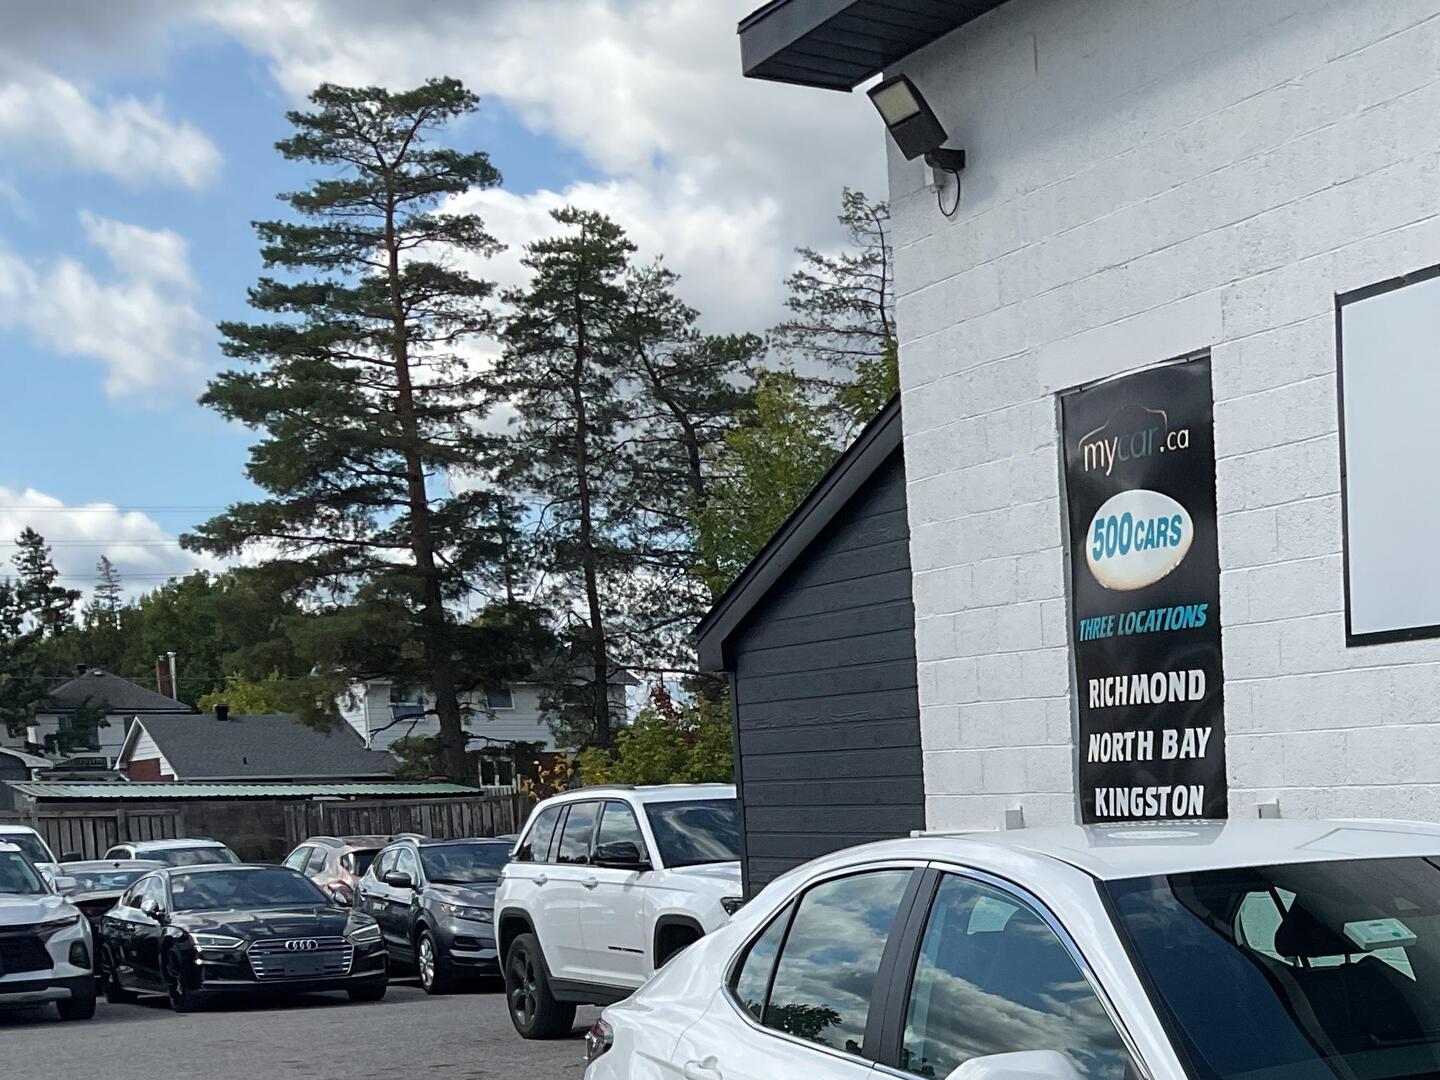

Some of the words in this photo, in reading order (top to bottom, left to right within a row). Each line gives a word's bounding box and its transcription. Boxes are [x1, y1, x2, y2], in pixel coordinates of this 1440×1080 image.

[1084, 427, 1189, 476] mycar.ca
[1079, 615, 1116, 642] THREE
[1117, 603, 1208, 636] LOCATIONS
[1088, 669, 1206, 709] RICHMOND
[1087, 730, 1154, 763] NORTH
[1161, 727, 1212, 760] BAY
[1094, 785, 1204, 817] KINGSTON
